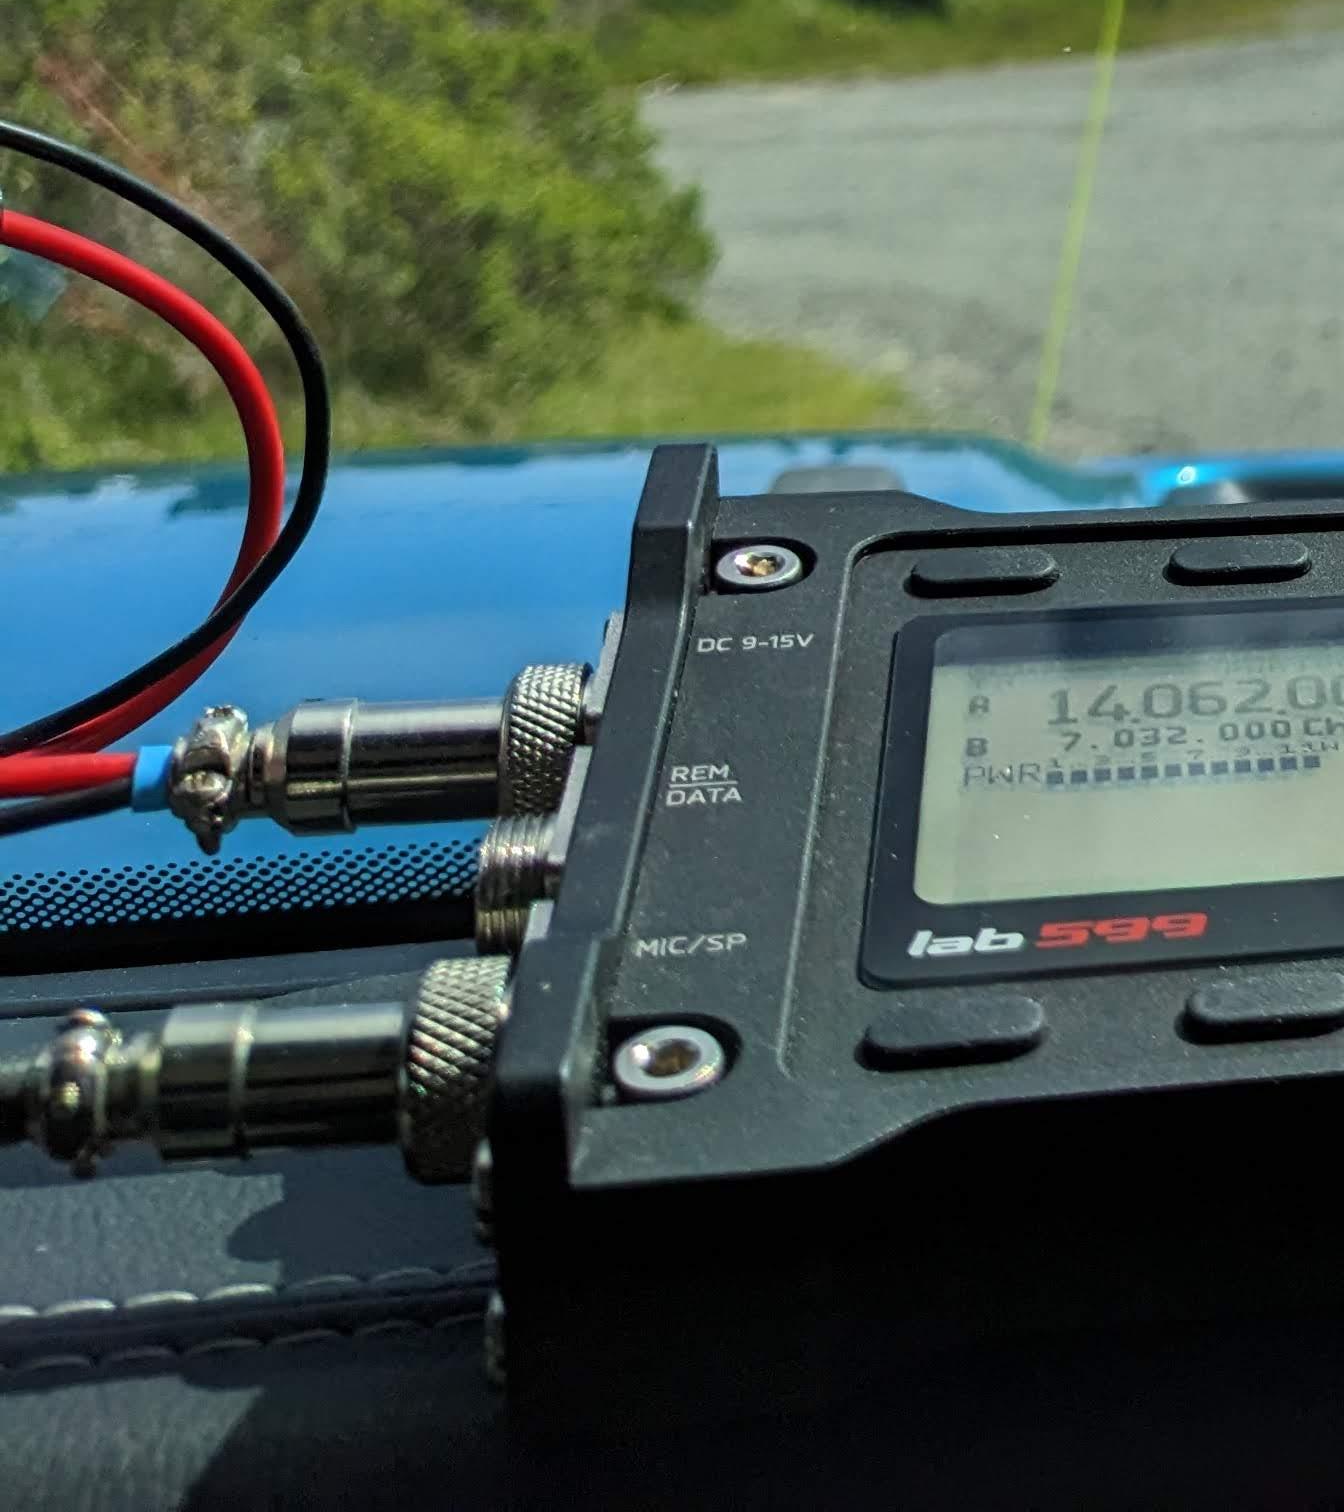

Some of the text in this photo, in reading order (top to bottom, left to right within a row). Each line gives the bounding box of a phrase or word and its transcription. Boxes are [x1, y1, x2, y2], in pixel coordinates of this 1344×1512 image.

[697, 633, 814, 654] DC 9-15V
[968, 695, 990, 716] A
[965, 737, 988, 758] B
[671, 765, 729, 782] REM
[963, 763, 1041, 786] PWR
[666, 788, 742, 805] DATA
[636, 933, 747, 957] MIC/SP
[906, 912, 1208, 958] lab 599
